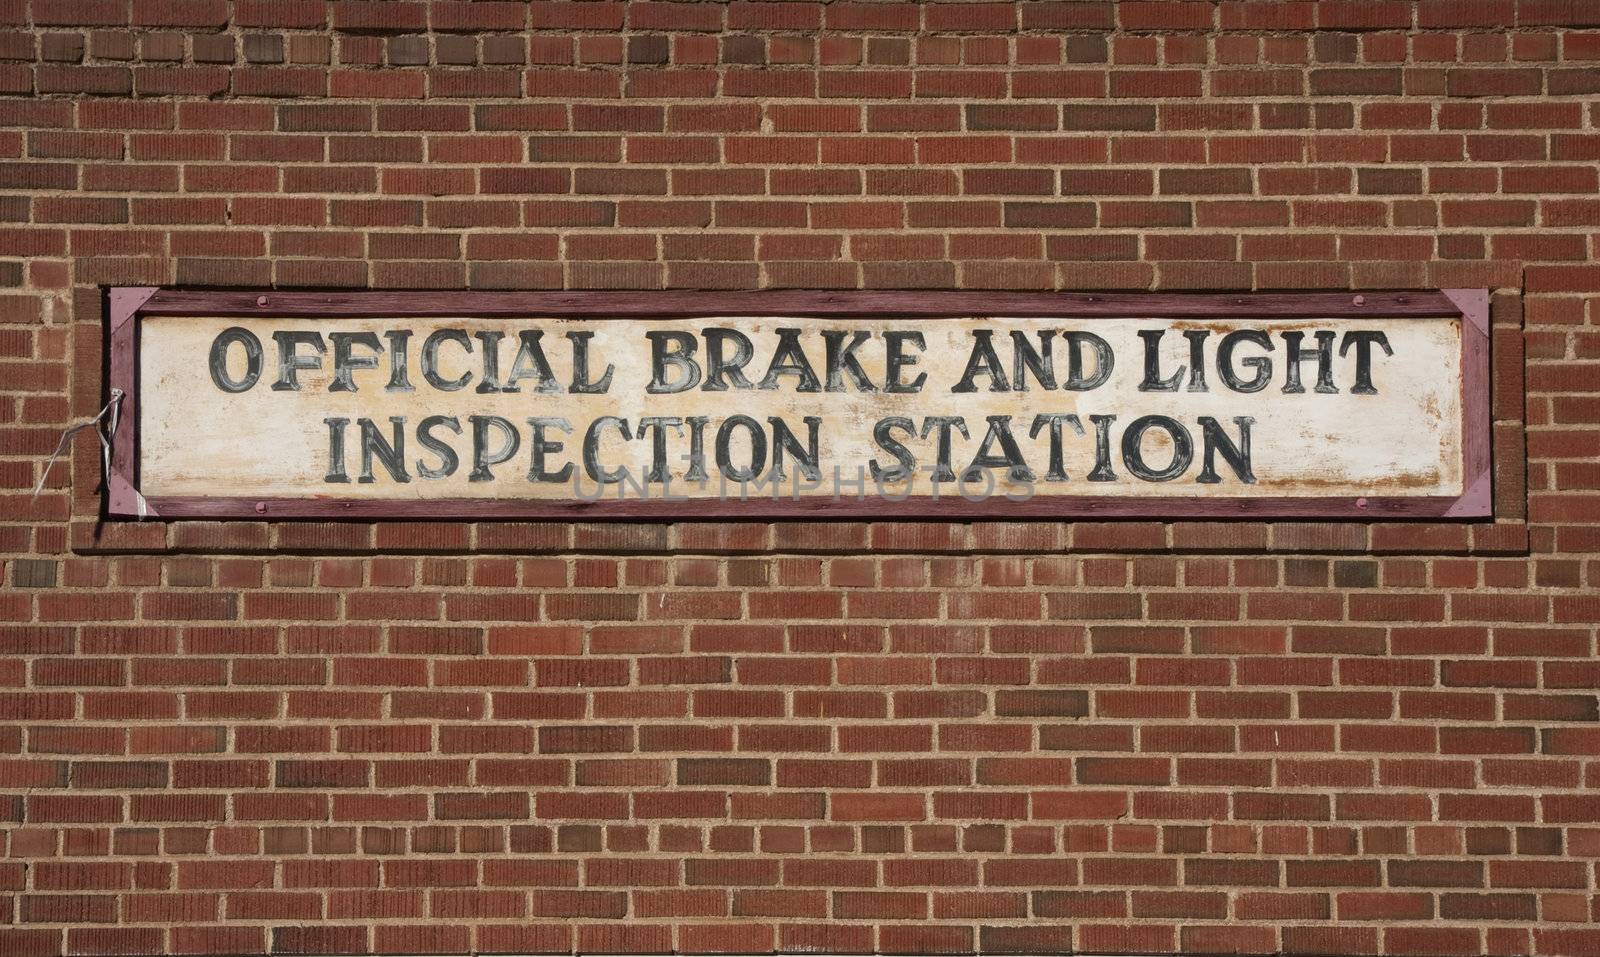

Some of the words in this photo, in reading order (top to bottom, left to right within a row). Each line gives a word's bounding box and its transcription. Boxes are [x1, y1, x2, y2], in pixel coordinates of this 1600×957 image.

[208, 326, 615, 394] OFFICIAL
[645, 327, 927, 394] BRAKE
[951, 329, 1116, 393] AND
[1137, 329, 1395, 395] LIGHT
[323, 415, 823, 484] INSPECTION
[868, 415, 1258, 484] STATION
